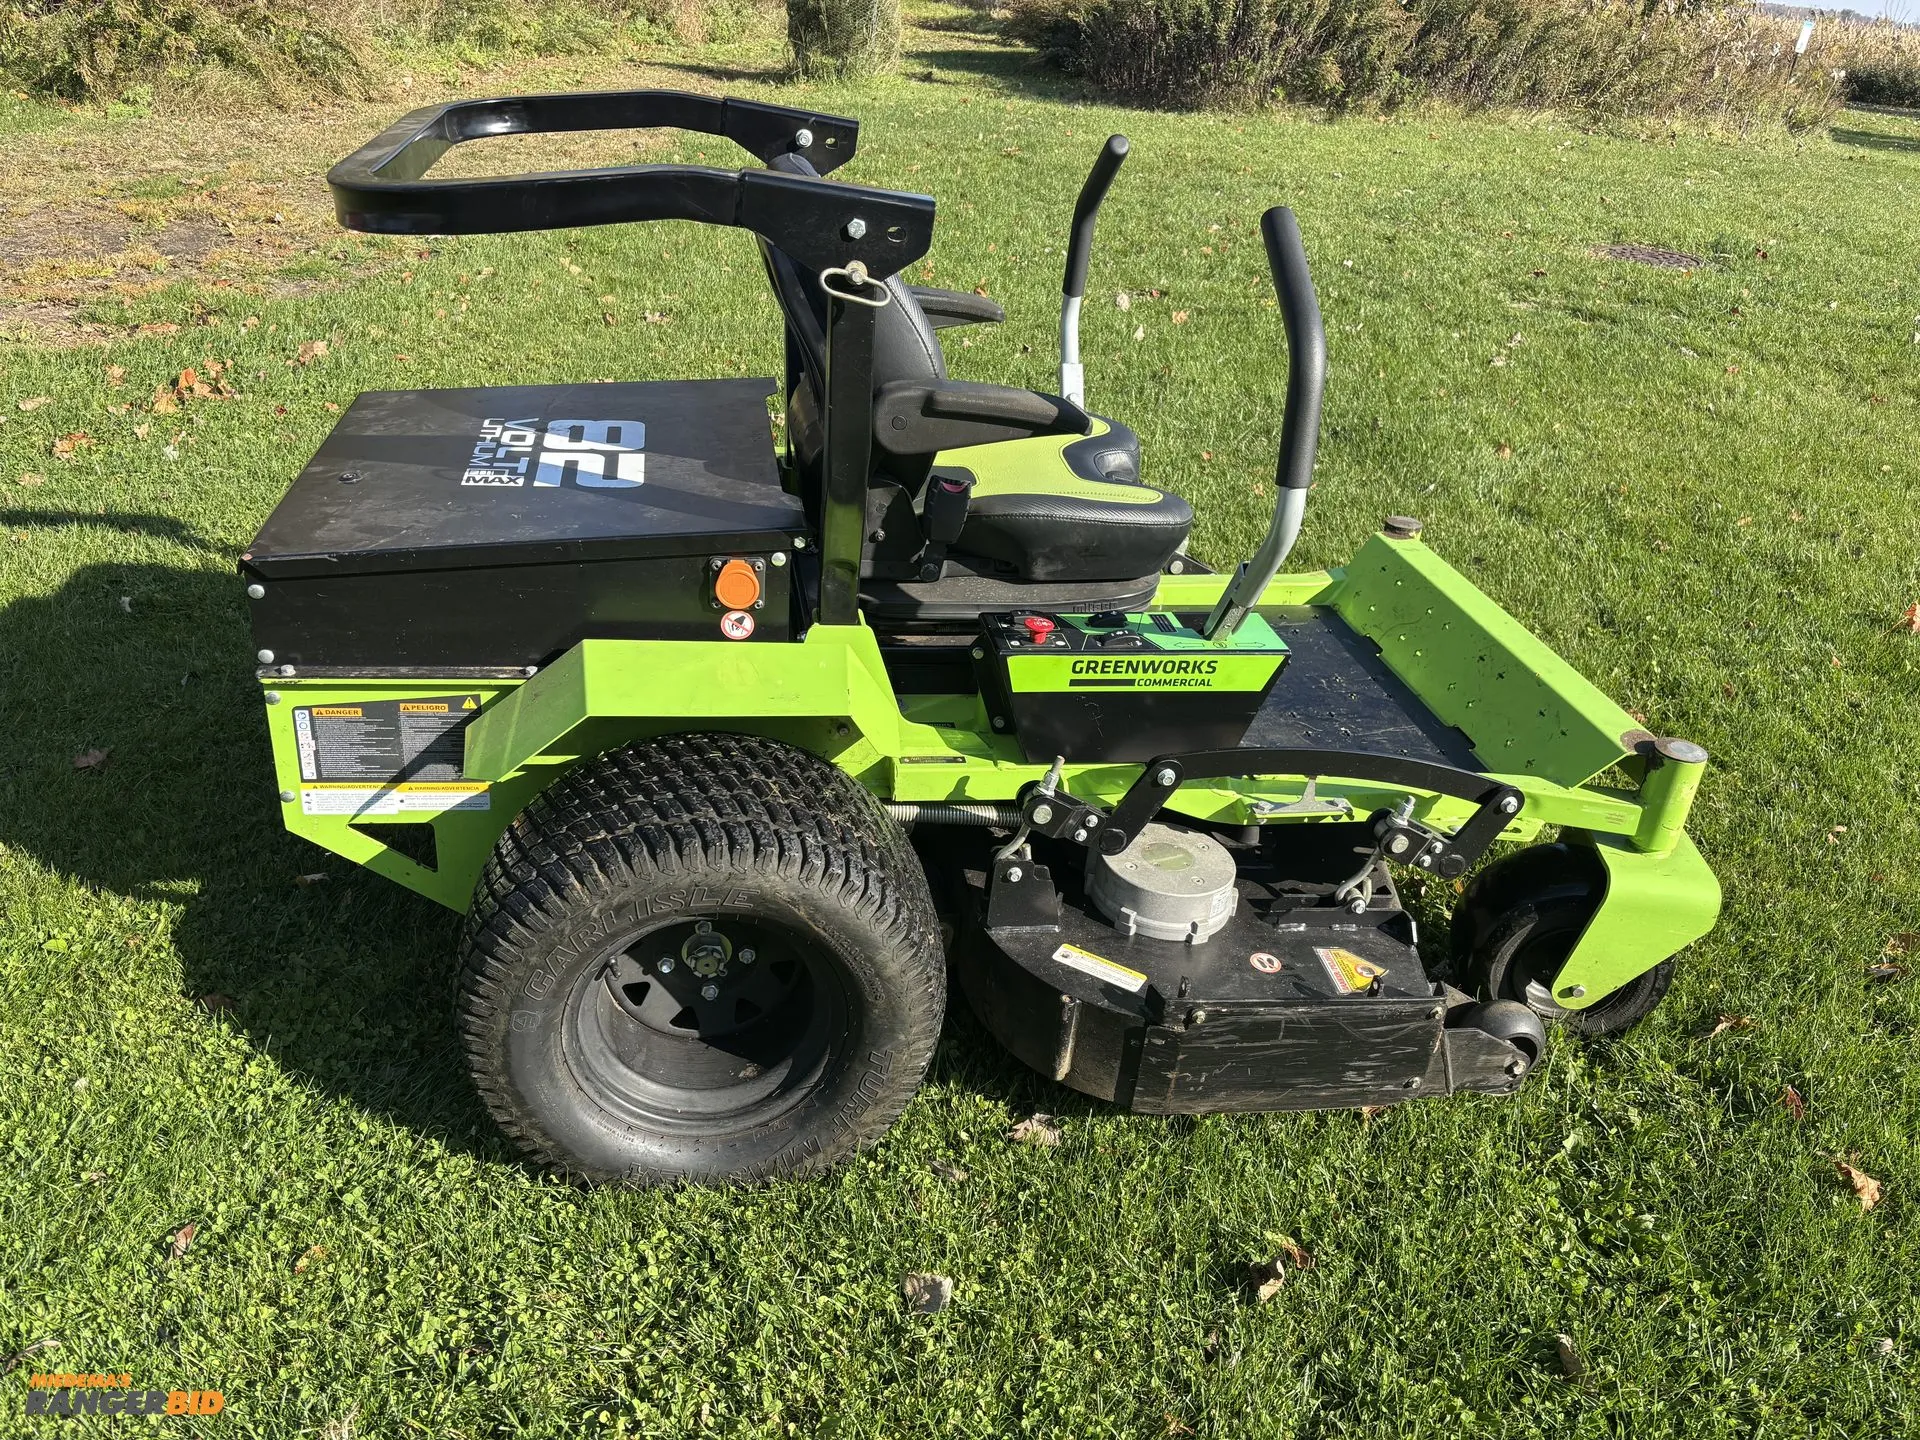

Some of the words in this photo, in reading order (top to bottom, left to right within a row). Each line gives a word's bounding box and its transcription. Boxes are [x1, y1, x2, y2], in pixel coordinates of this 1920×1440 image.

[469, 418, 505, 466] LITHIUM
[493, 418, 539, 474] VOLT
[533, 419, 645, 488] 82
[465, 476, 522, 485] MAX
[1071, 659, 1218, 675] GREENWORKS
[1136, 678, 1213, 687] COMMERCIAL
[523, 887, 761, 1001] CARLISLE
[832, 1049, 895, 1143] TURF
